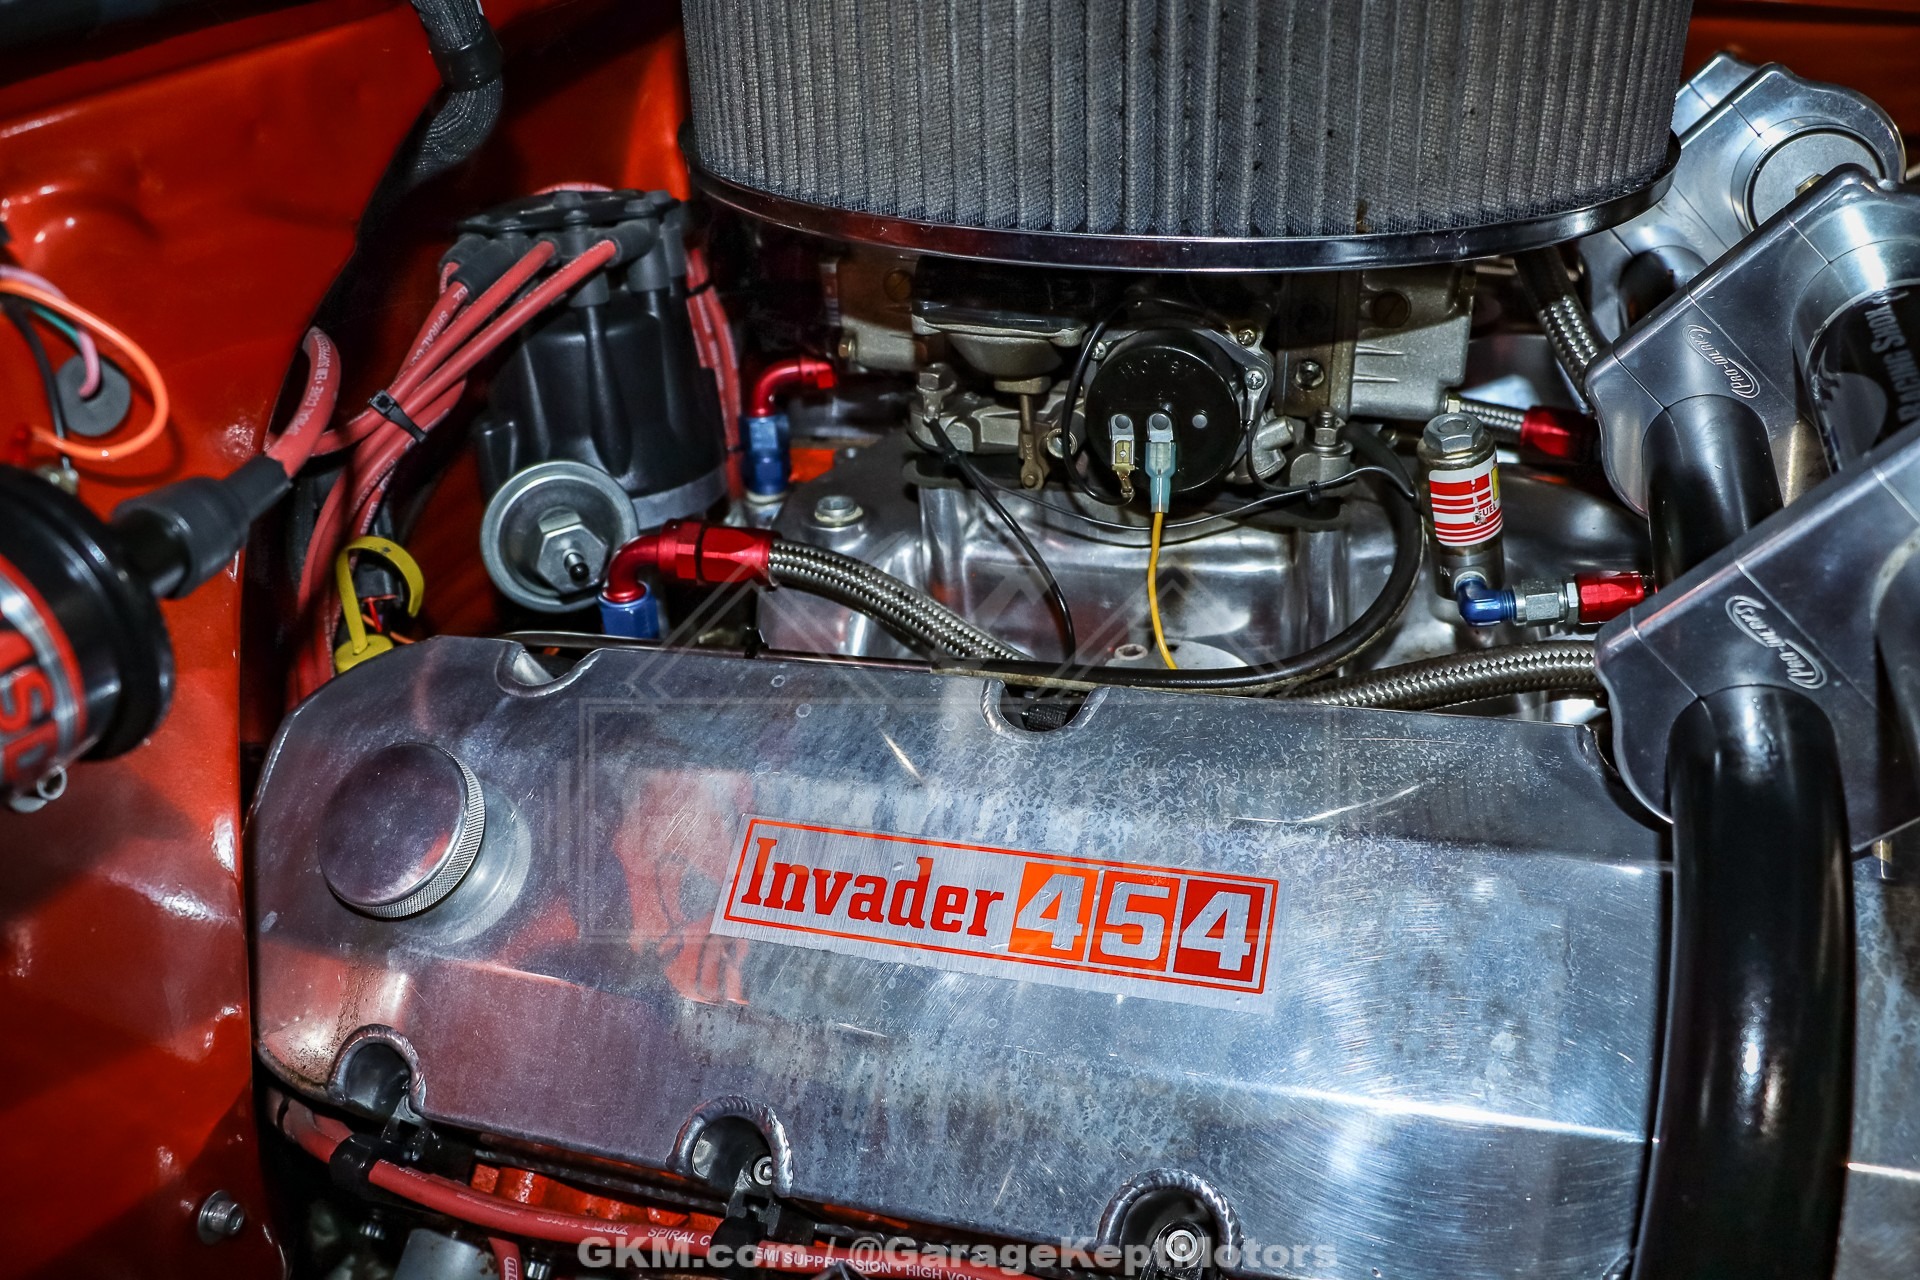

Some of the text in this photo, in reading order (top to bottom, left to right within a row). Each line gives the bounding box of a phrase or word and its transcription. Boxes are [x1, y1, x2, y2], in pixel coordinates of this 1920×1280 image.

[420, 310, 449, 347] SPIRAL
[1865, 304, 1906, 353] SHOX
[740, 837, 1252, 972] Invader 454
[647, 1227, 696, 1245] SPIRAL
[755, 1247, 780, 1262] EMI
[906, 1264, 942, 1280] HIGH
